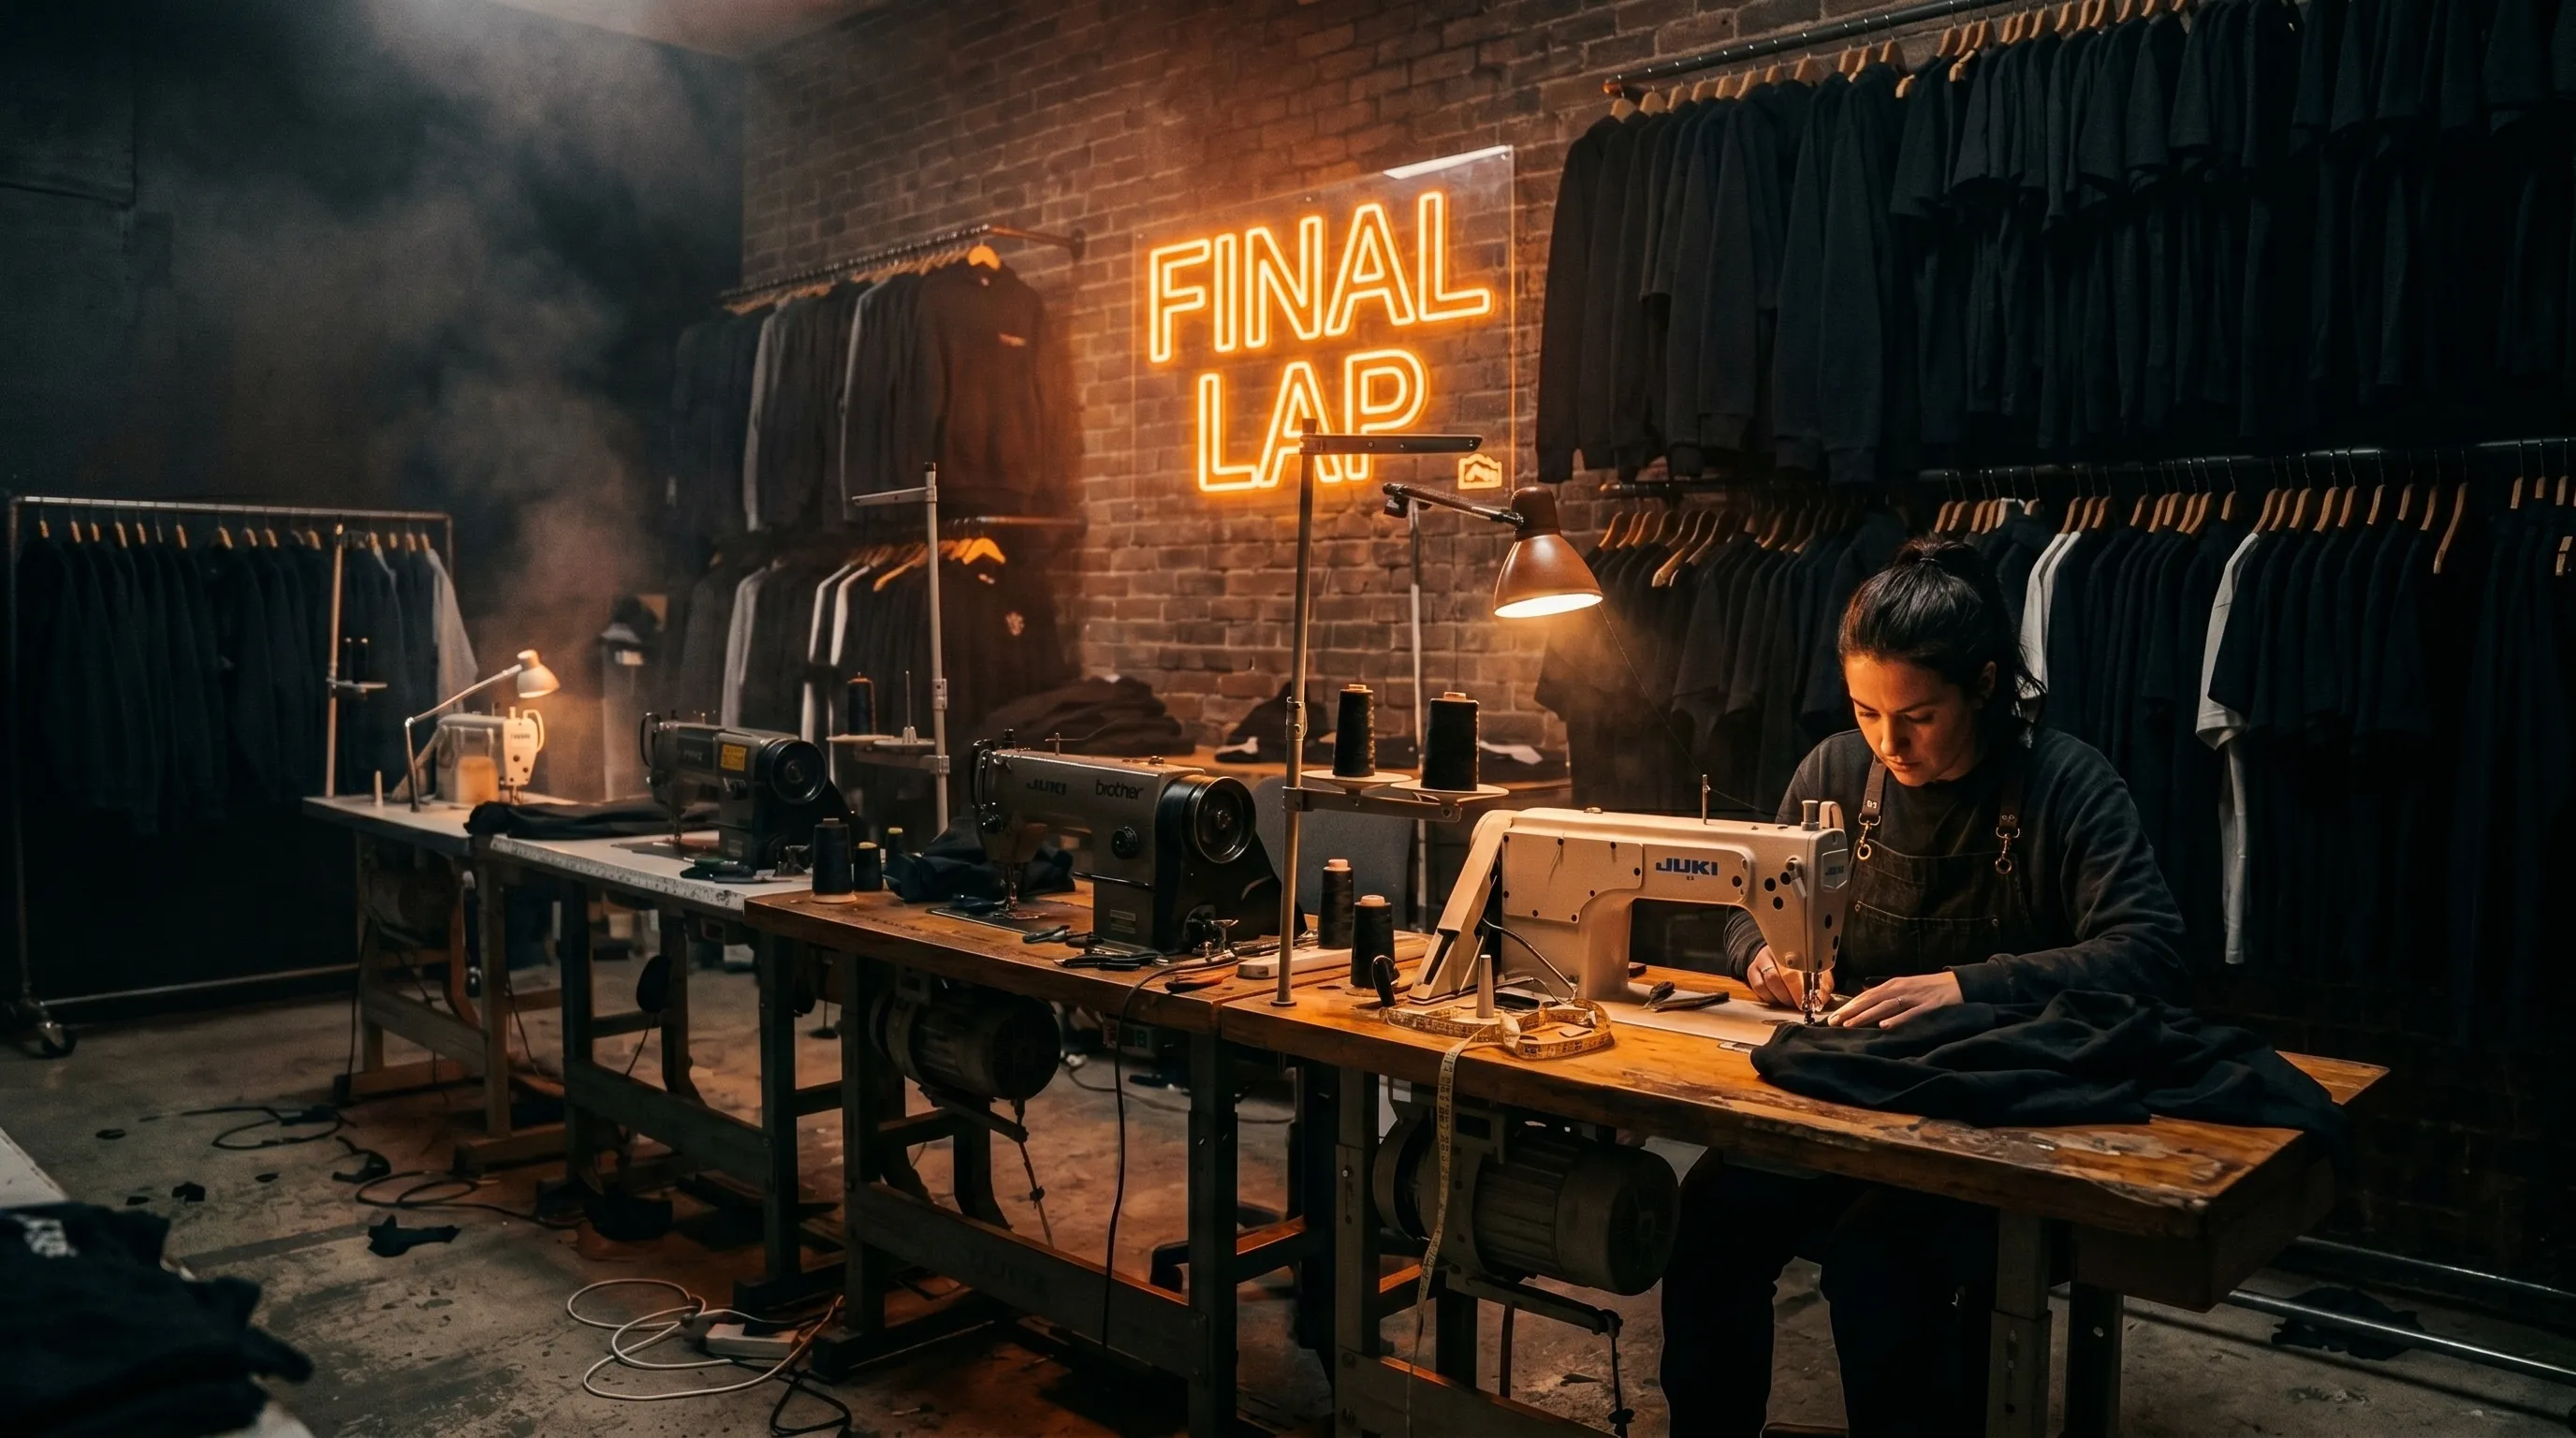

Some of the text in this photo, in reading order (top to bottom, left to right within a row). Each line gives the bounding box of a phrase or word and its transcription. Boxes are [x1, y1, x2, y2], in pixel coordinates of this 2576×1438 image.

[1149, 191, 1492, 363] FINAL
[1198, 349, 1426, 492] LAP
[1095, 779, 1143, 800] brother
[1655, 858, 1718, 875] JUKI
